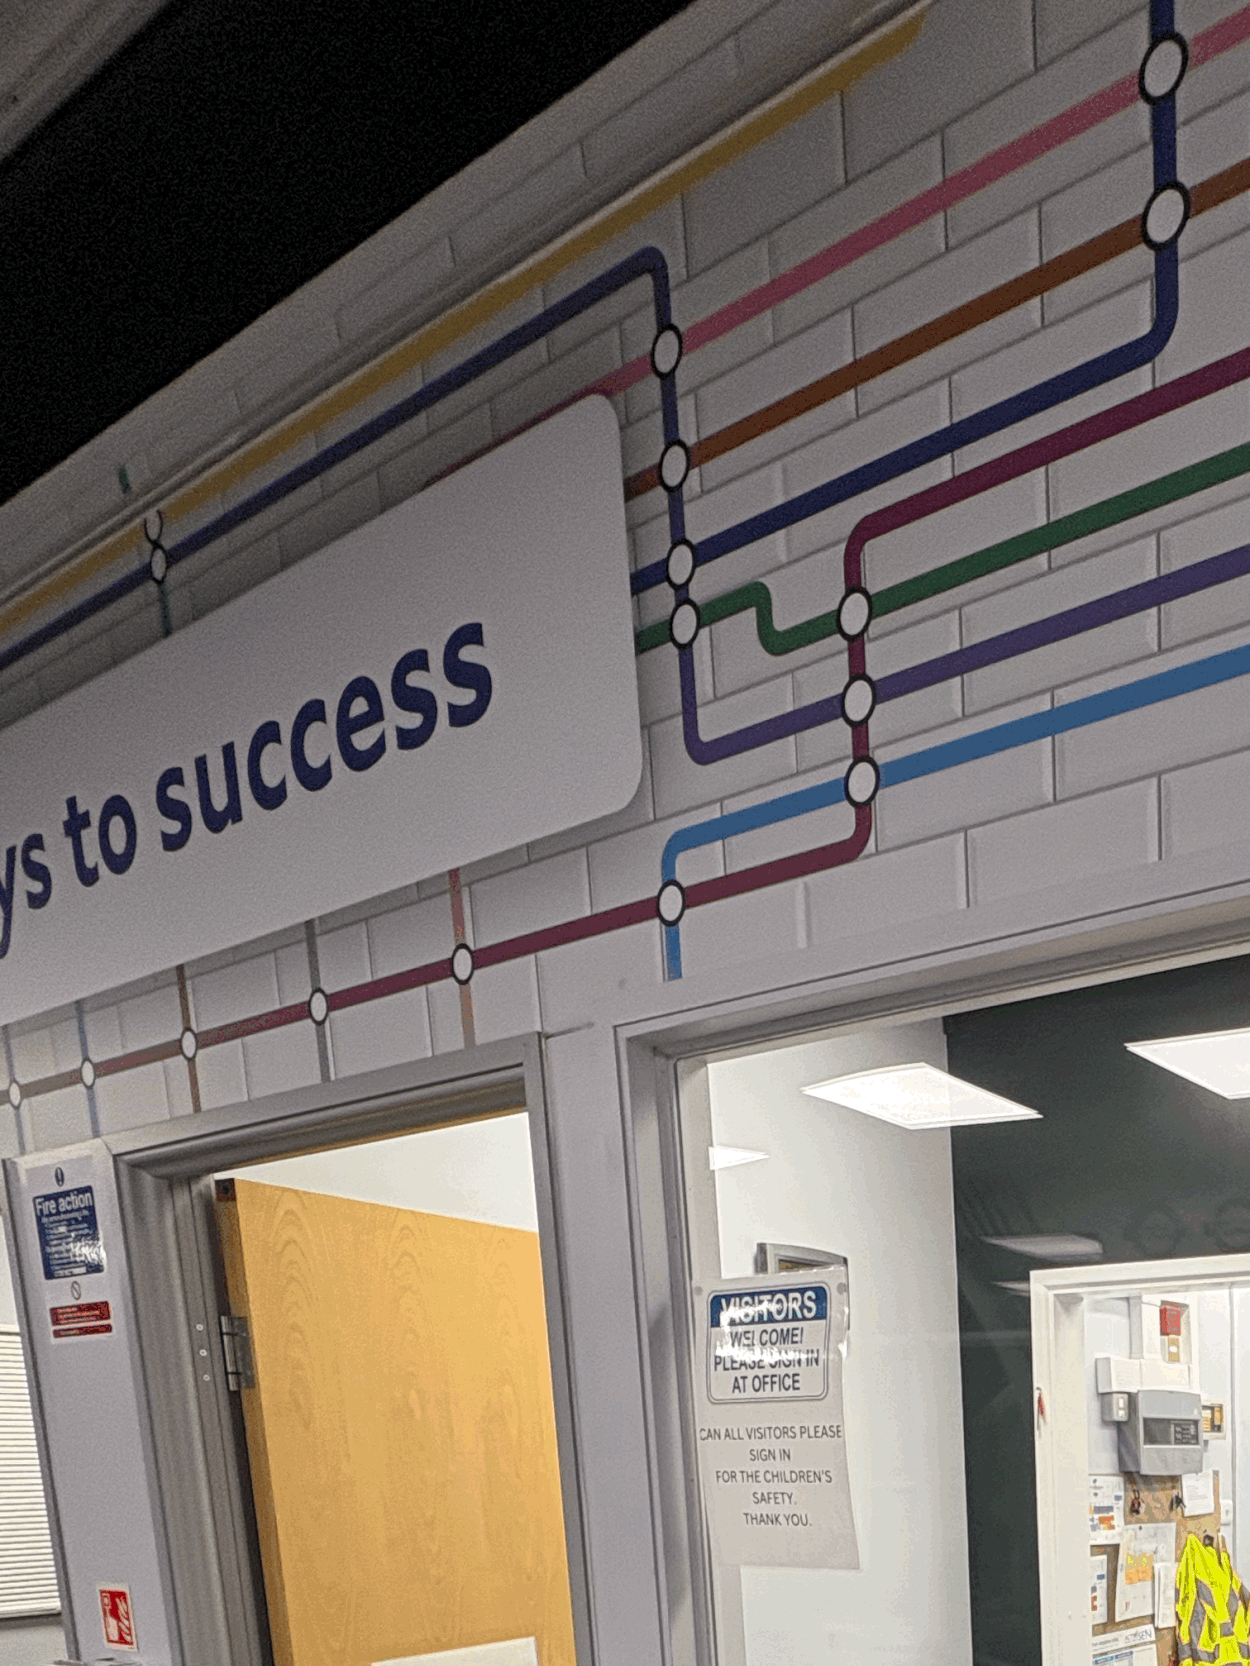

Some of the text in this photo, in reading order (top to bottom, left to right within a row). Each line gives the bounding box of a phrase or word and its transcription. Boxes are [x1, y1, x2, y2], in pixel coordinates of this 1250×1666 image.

[63, 795, 137, 887] to
[156, 622, 492, 851] success
[35, 1191, 93, 1216] Fire action
[721, 1290, 816, 1323] VISITORS
[806, 1348, 819, 1367] IN
[732, 1373, 800, 1393] AT OFFICE
[699, 1425, 842, 1441] CAN ALL VISITORS PLEASE
[749, 1448, 791, 1462] SIGN IN
[715, 1470, 832, 1483] FOR THE CHILDREN'S
[752, 1492, 797, 1505] SAFETY.
[743, 1512, 812, 1527] THANK YOU.
